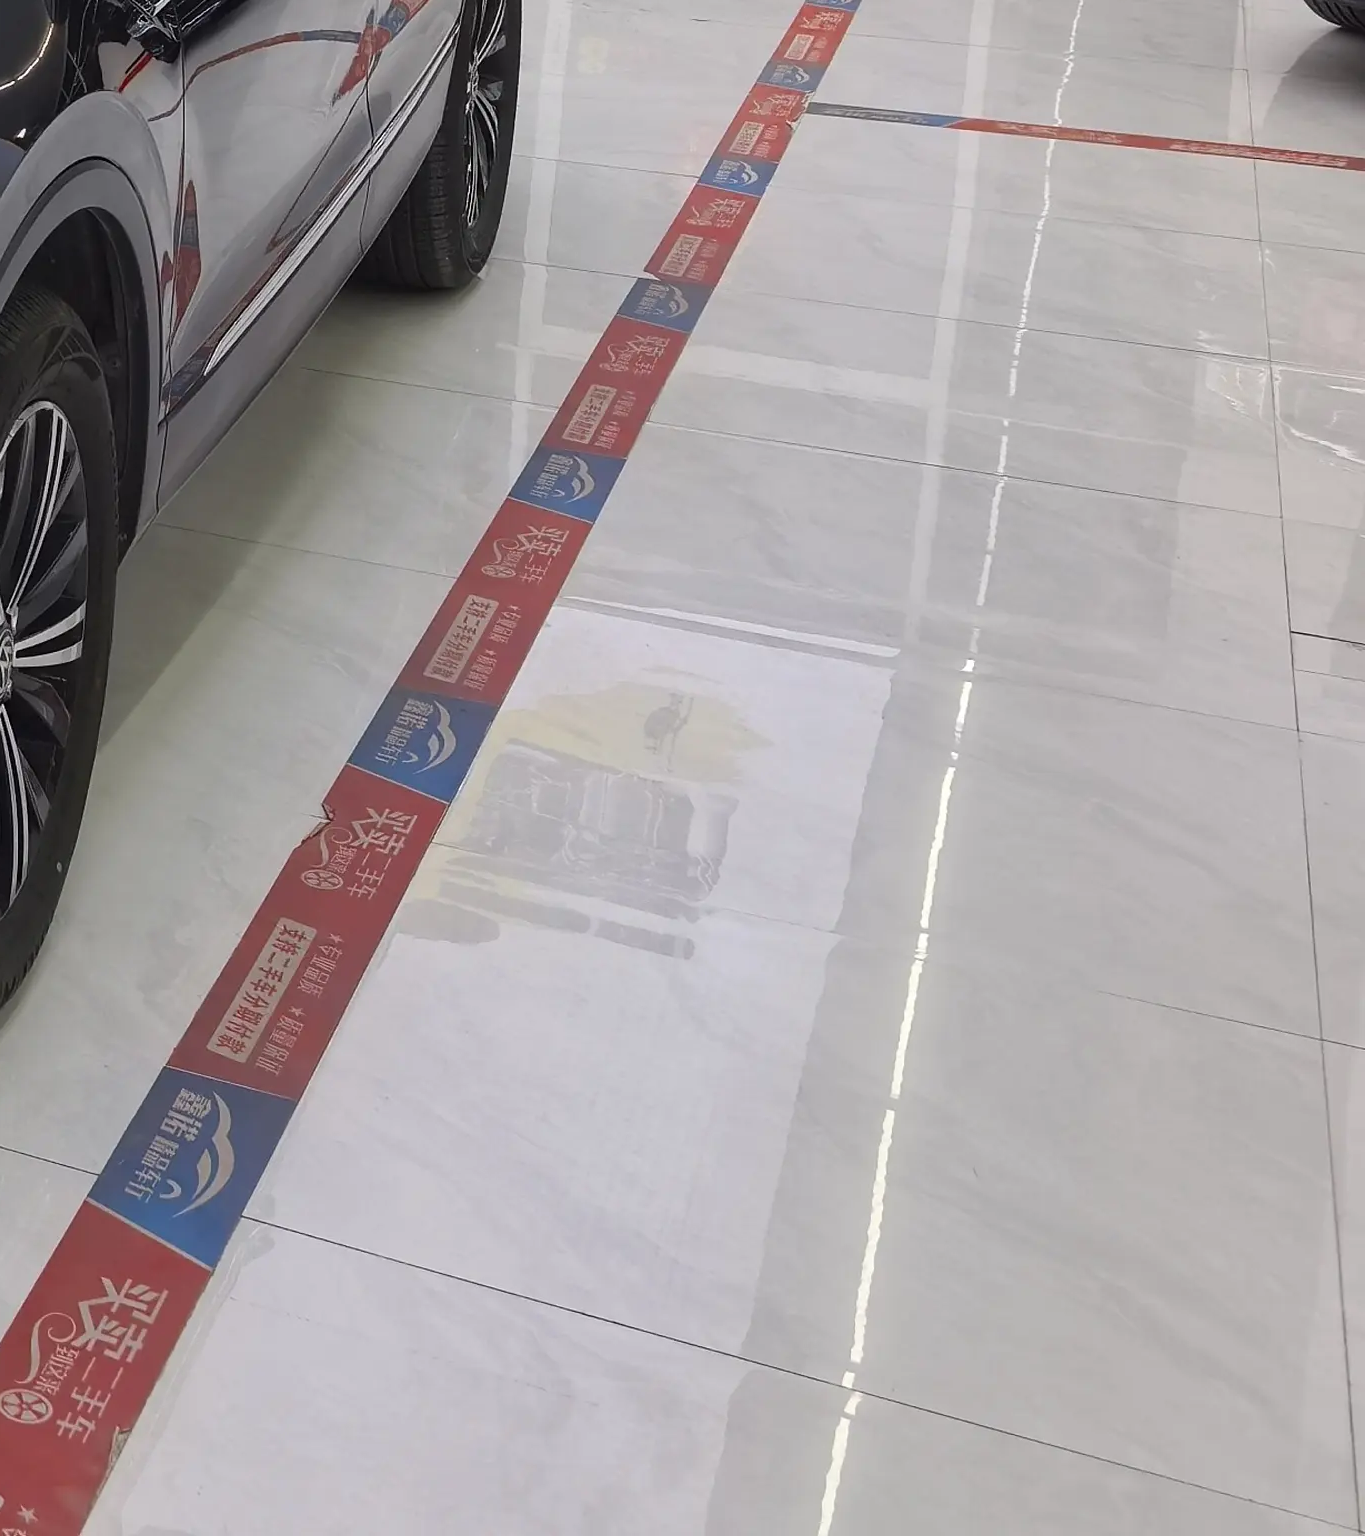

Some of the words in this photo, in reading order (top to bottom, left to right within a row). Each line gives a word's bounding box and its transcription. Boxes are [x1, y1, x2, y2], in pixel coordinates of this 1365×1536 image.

[347, 806, 418, 901] 买卖二手车
[216, 924, 308, 1056] 支持二手车分期付款
[296, 944, 344, 999] 专业品质
[254, 1014, 305, 1076] 质量保证
[159, 1088, 213, 1143] 鑫诺
[124, 1134, 182, 1204] 精品车行
[57, 1276, 169, 1444] 买卖二手车
